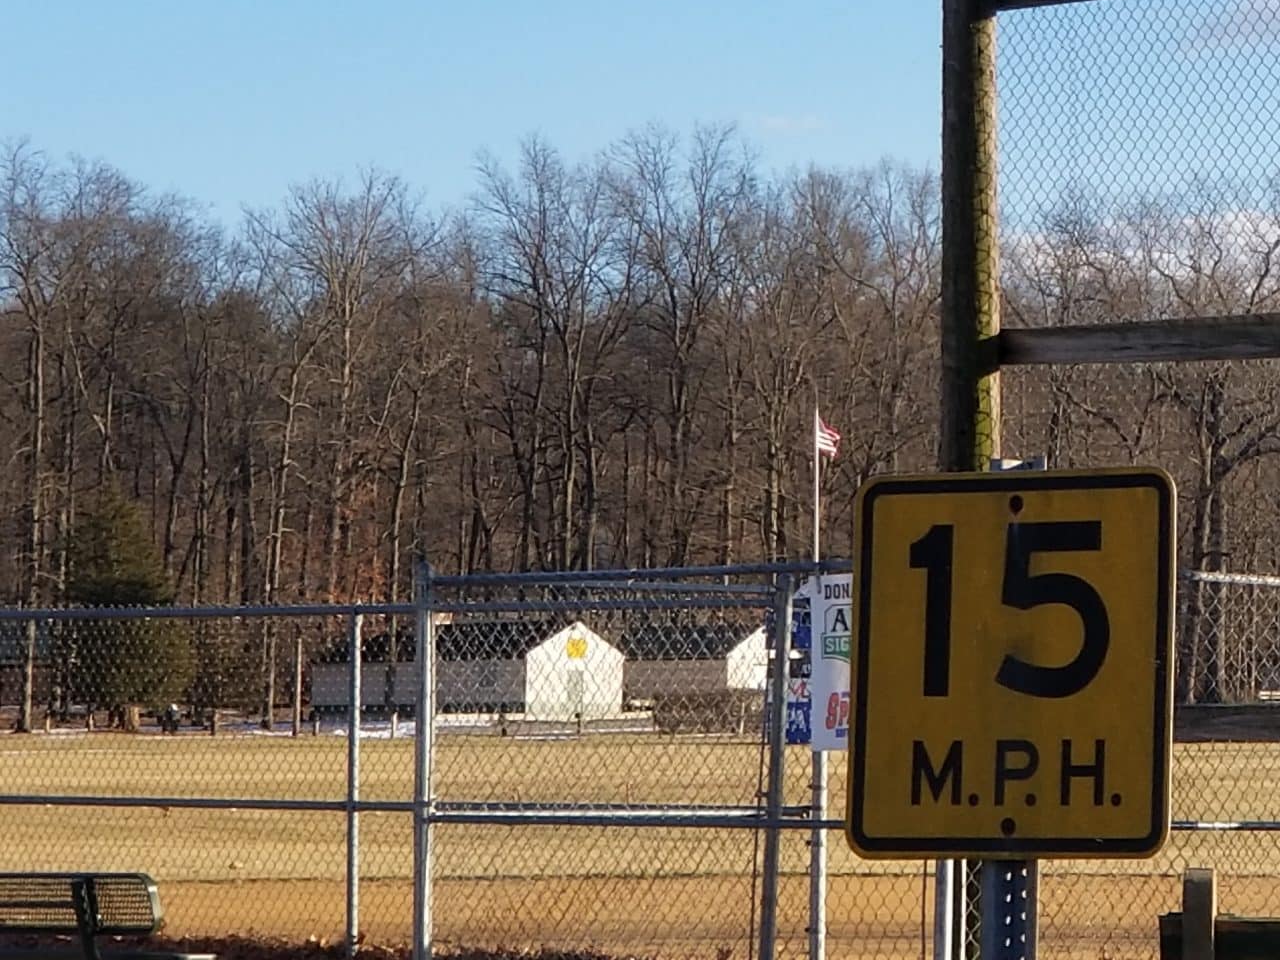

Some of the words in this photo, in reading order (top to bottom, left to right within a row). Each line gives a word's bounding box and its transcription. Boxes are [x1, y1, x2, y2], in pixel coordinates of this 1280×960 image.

[824, 583, 852, 600] DON
[909, 520, 1110, 699] 15
[825, 692, 850, 730] SP
[910, 740, 1122, 806] M.P.H.
